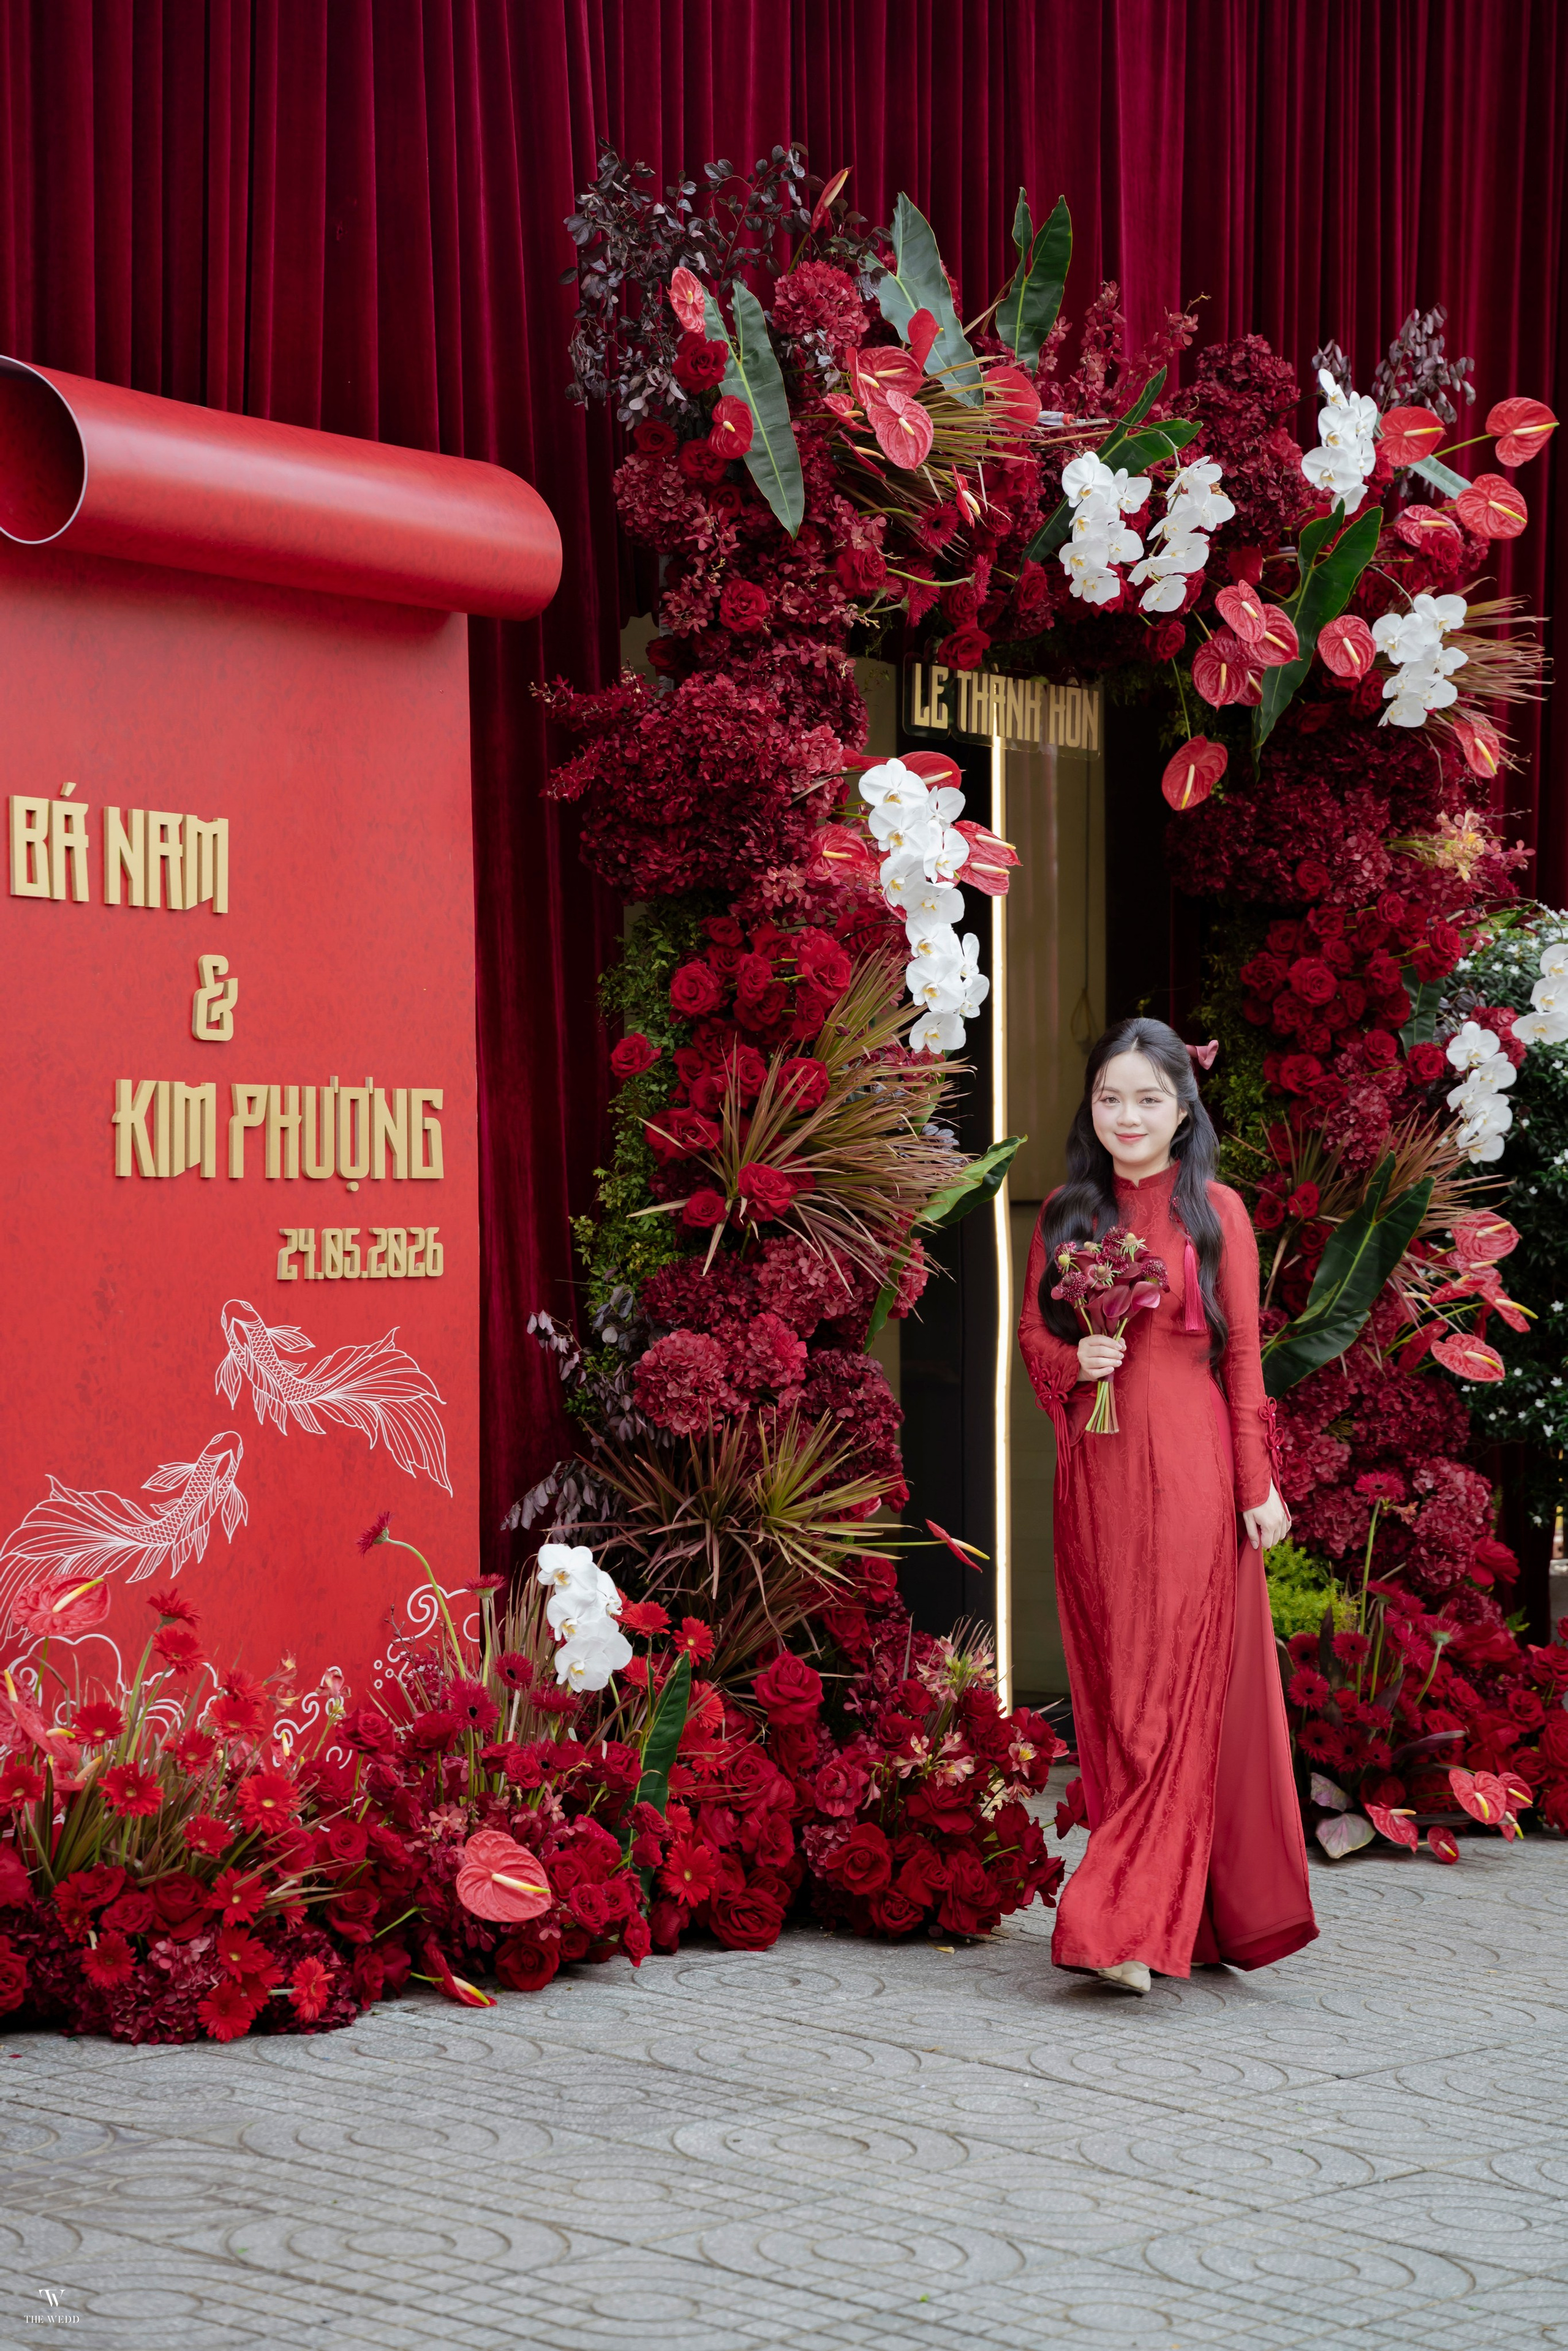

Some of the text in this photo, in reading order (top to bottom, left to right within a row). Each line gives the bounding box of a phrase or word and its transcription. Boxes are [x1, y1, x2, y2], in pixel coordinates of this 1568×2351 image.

[1047, 676, 1100, 751] HÔN
[9, 782, 229, 913] BÁ NAM
[192, 954, 238, 1041] &
[112, 1076, 444, 1192] KIM PHƯỢNG
[277, 1227, 444, 1280] 24.05.2026
